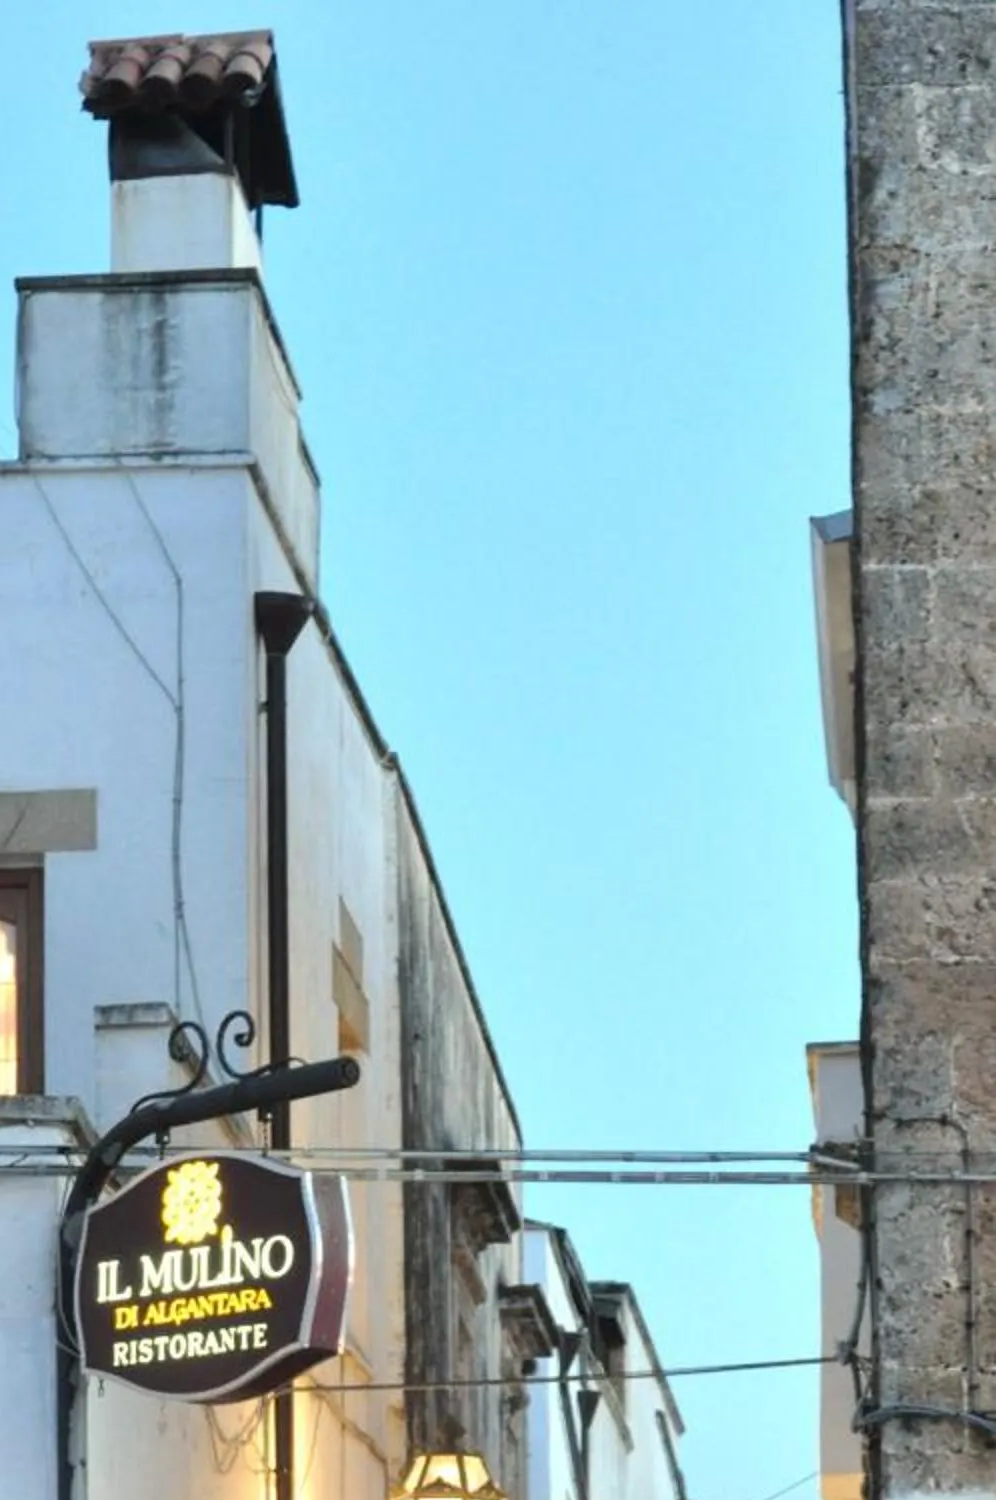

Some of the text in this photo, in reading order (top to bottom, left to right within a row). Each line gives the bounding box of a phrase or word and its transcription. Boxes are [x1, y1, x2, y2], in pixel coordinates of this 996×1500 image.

[97, 1226, 294, 1303] IL MULINO
[115, 1305, 139, 1330] DI
[113, 1323, 268, 1367] RISTORANTE
